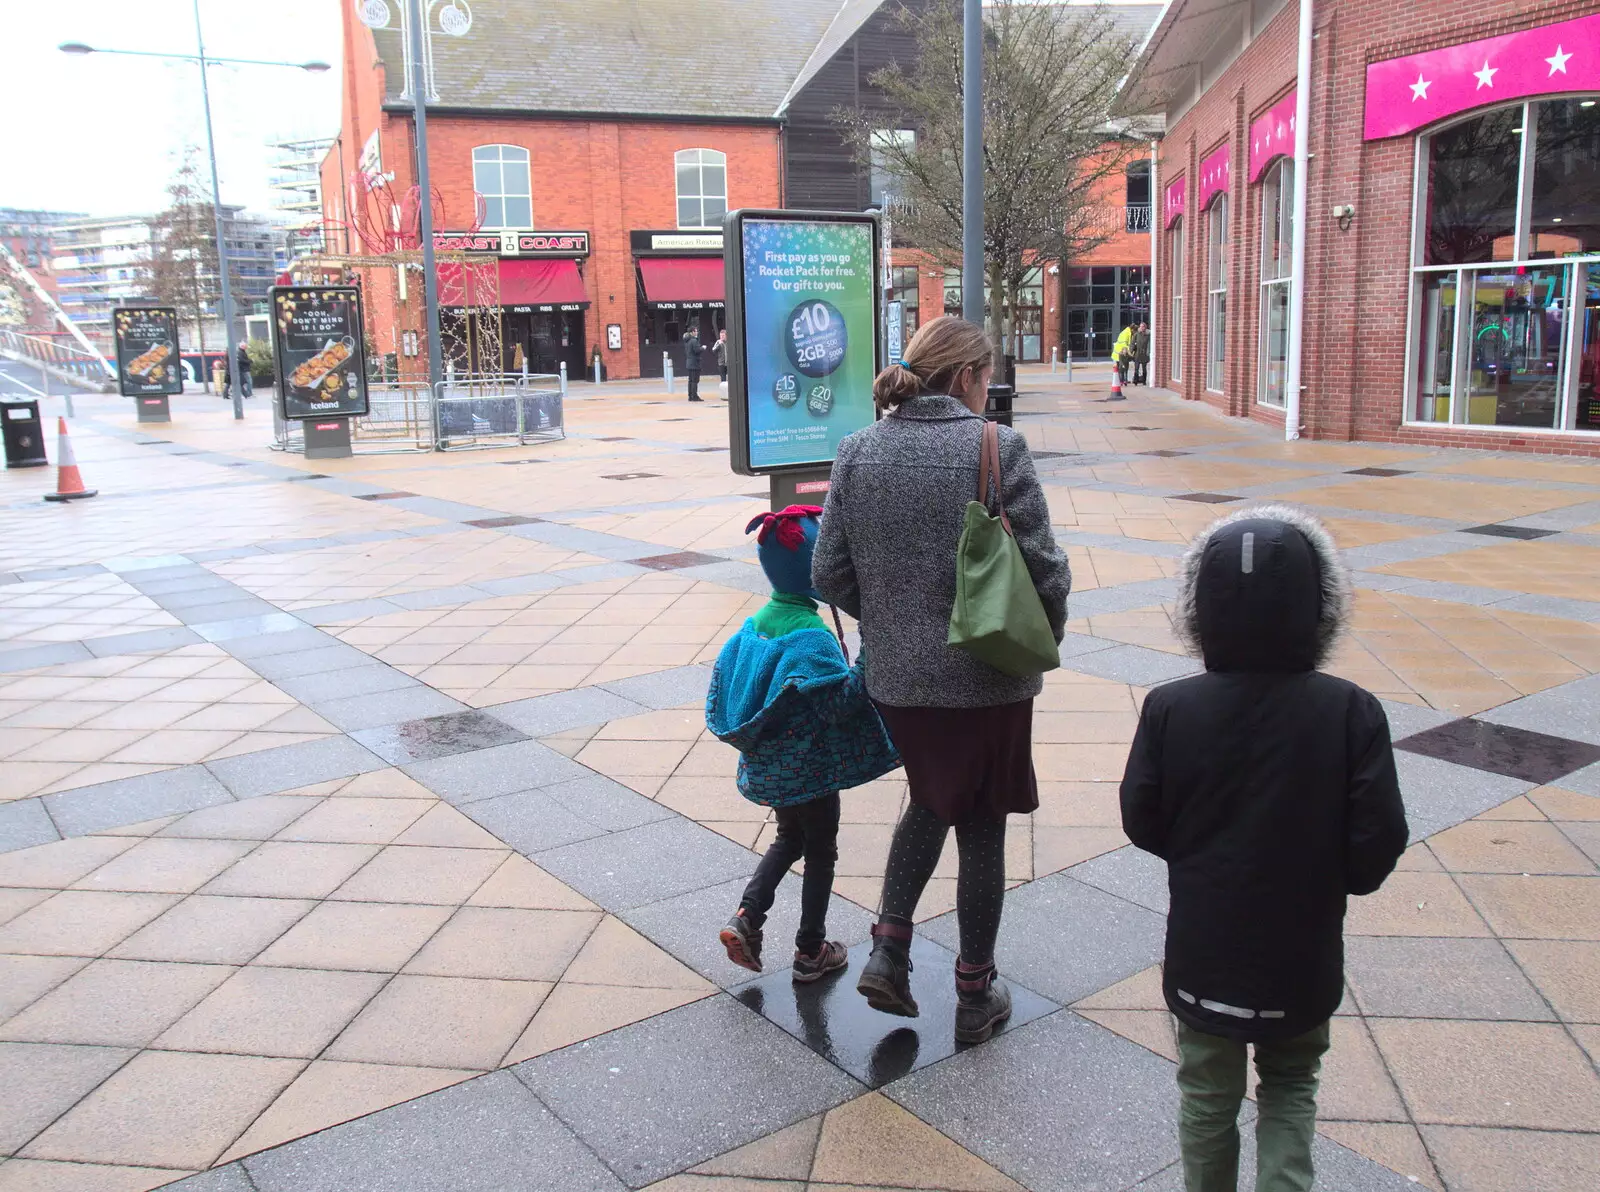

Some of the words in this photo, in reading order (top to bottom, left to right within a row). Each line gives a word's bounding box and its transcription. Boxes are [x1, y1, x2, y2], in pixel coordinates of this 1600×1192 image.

[432, 237, 500, 250] COAST
[505, 235, 515, 251] TO
[520, 237, 585, 250] COAST
[696, 238, 723, 246] Restau
[765, 250, 787, 262] First
[789, 254, 806, 265] pay
[808, 254, 819, 262] as
[820, 254, 838, 265] you
[839, 254, 851, 265] go
[759, 265, 795, 276] Rocket
[796, 265, 819, 276] Pack
[820, 265, 834, 276] for
[835, 265, 856, 276] free.
[773, 279, 792, 291] Our
[793, 279, 812, 293] gift
[813, 281, 823, 291] to
[824, 281, 845, 292] you.
[320, 316, 344, 324] MIND
[791, 303, 830, 340] £10
[796, 343, 826, 362] 2GB
[775, 375, 796, 391] £15
[811, 385, 831, 401] £20
[310, 401, 339, 410] Iceland
